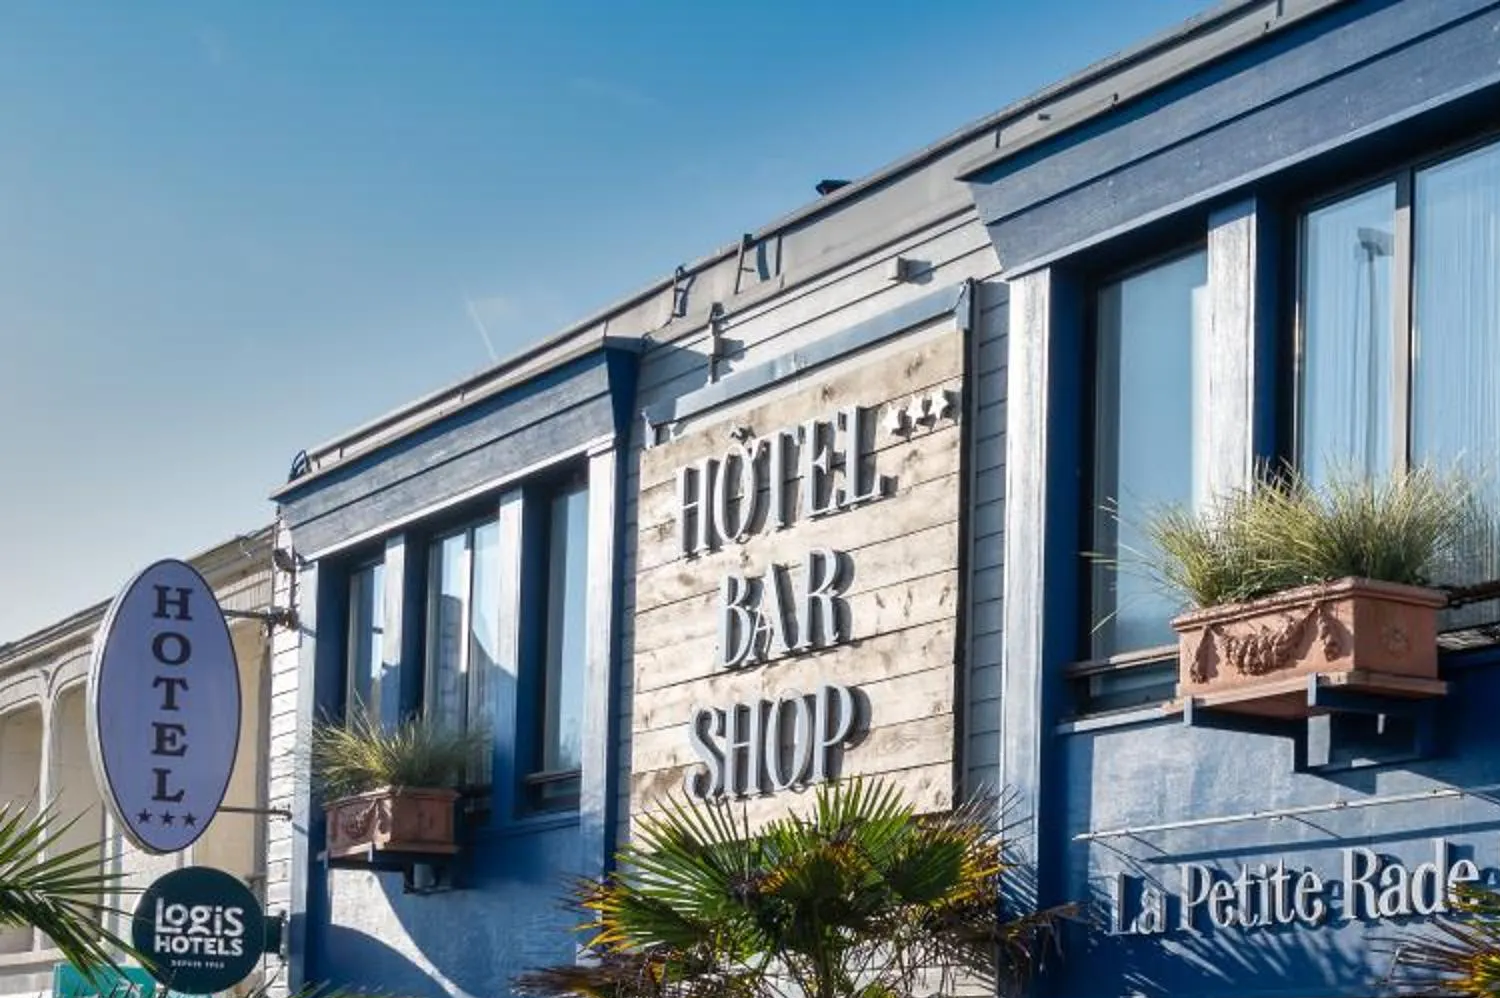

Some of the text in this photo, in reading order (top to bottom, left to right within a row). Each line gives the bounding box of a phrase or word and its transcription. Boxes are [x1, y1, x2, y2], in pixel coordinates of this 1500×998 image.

[676, 405, 884, 556] HÔTEL
[716, 547, 839, 668] BAR
[151, 584, 194, 804] HOTEL
[684, 682, 854, 802] SHOP
[154, 934, 244, 957] HOTELS
[1104, 870, 1168, 936] La
[1176, 855, 1325, 932] Petite
[1341, 836, 1481, 919] Rade
